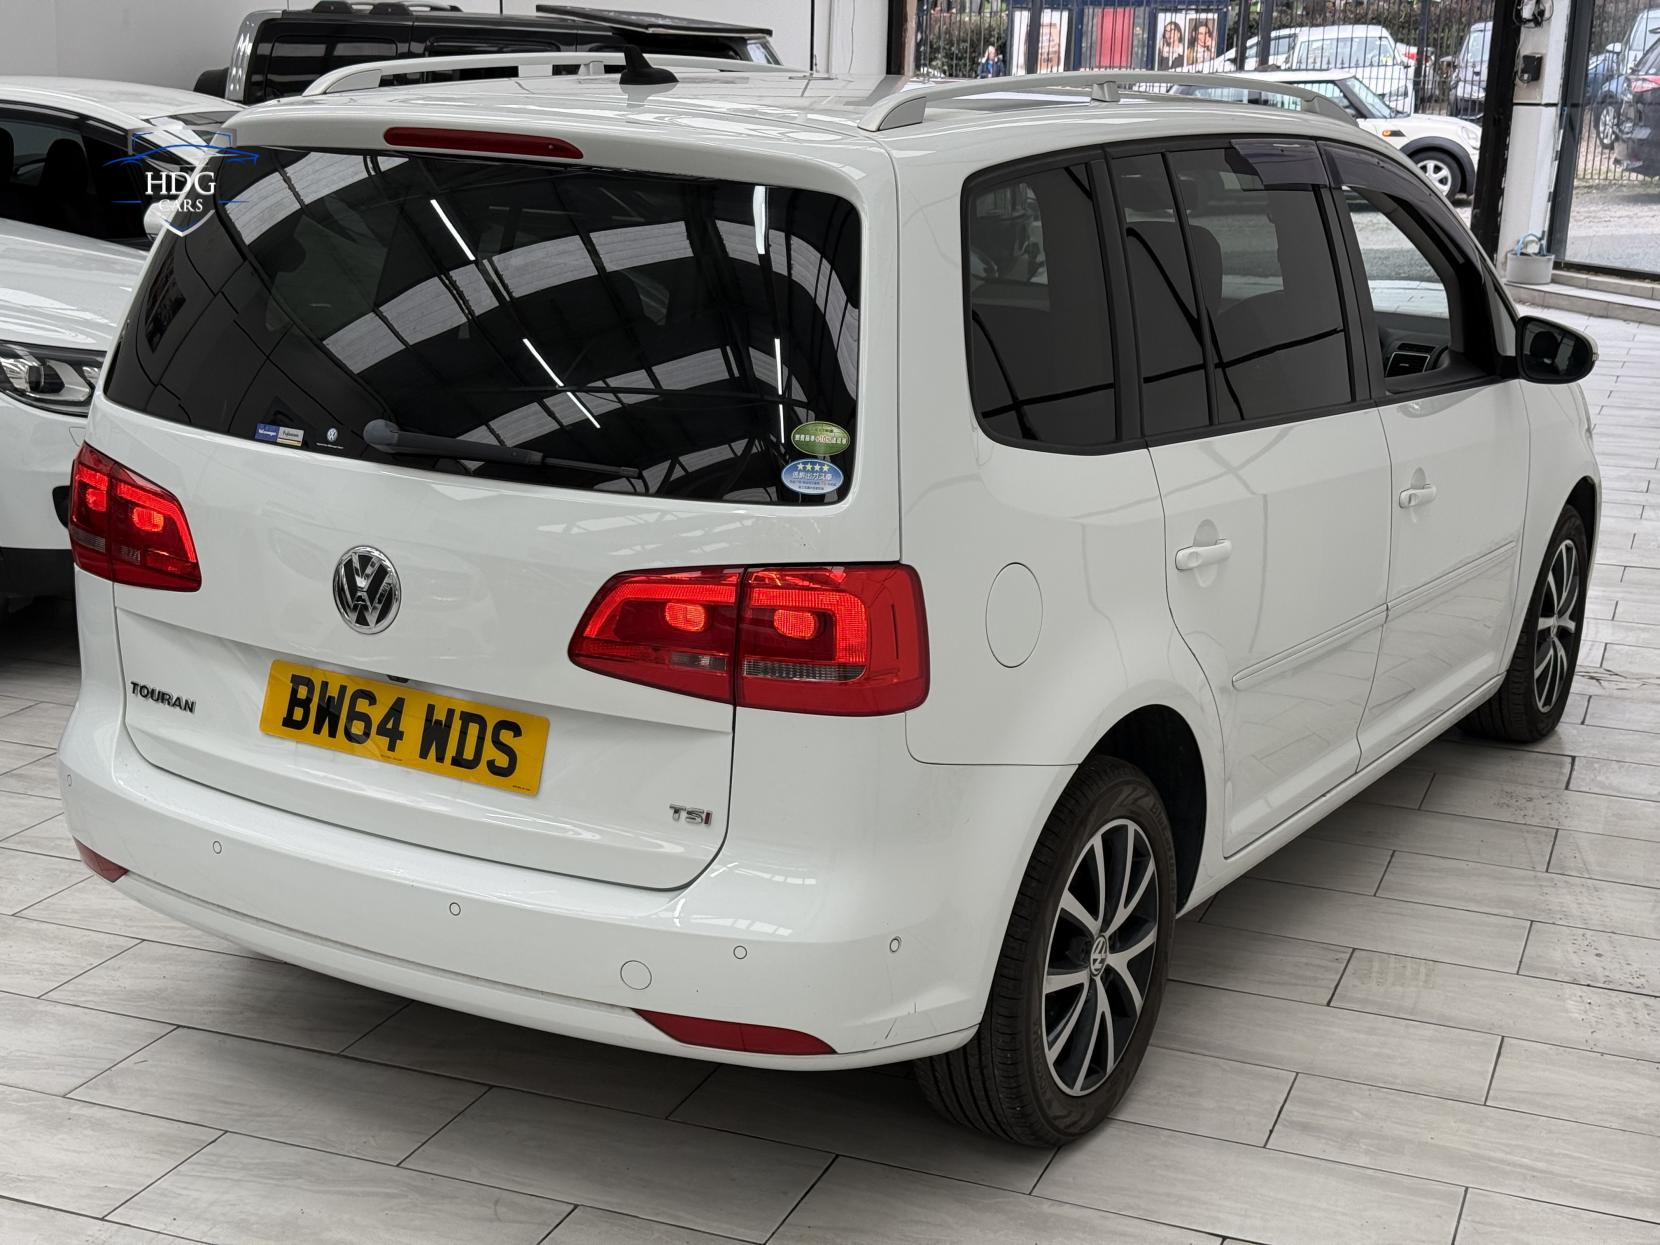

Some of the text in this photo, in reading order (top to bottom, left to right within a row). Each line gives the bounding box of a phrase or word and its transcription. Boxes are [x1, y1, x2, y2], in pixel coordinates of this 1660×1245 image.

[131, 681, 196, 714] TOURAN
[281, 673, 523, 778] BW64 WDS
[669, 803, 713, 827] TSI
